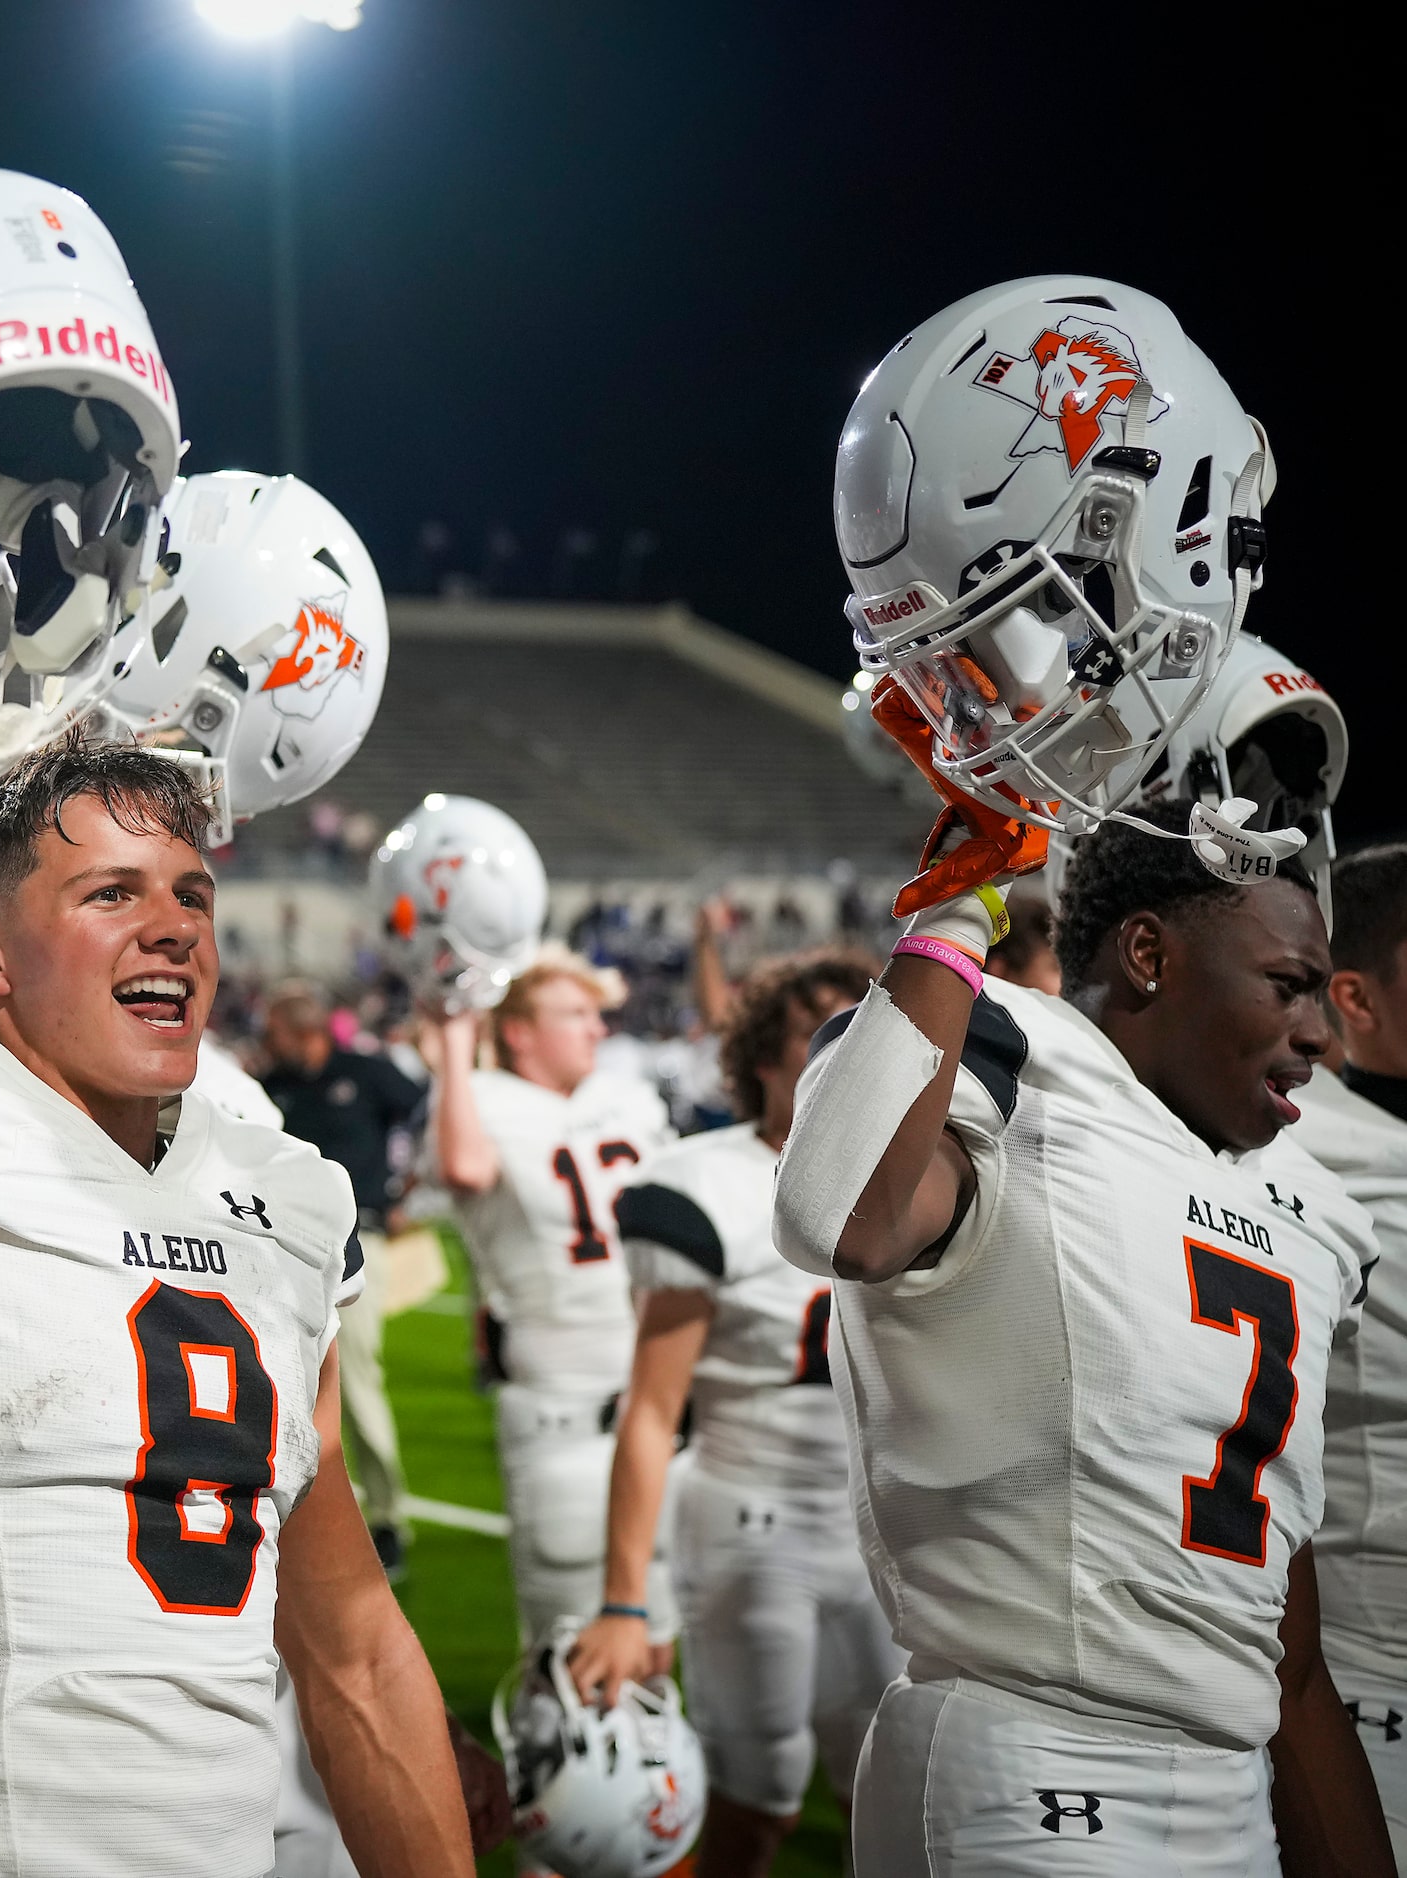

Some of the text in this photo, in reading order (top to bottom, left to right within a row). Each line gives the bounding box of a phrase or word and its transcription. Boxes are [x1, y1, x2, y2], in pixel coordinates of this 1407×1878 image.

[982, 356, 1014, 385] 10X
[1203, 820, 1215, 832] Star
[1217, 829, 1234, 842] Lone
[1235, 838, 1251, 847] The
[905, 938, 925, 949] Kind
[926, 942, 956, 962] Brave
[1186, 1193, 1274, 1256] ALEDO
[122, 1231, 228, 1275] ALEDO
[1180, 1235, 1300, 1567] 7
[125, 1277, 279, 1617] 8
